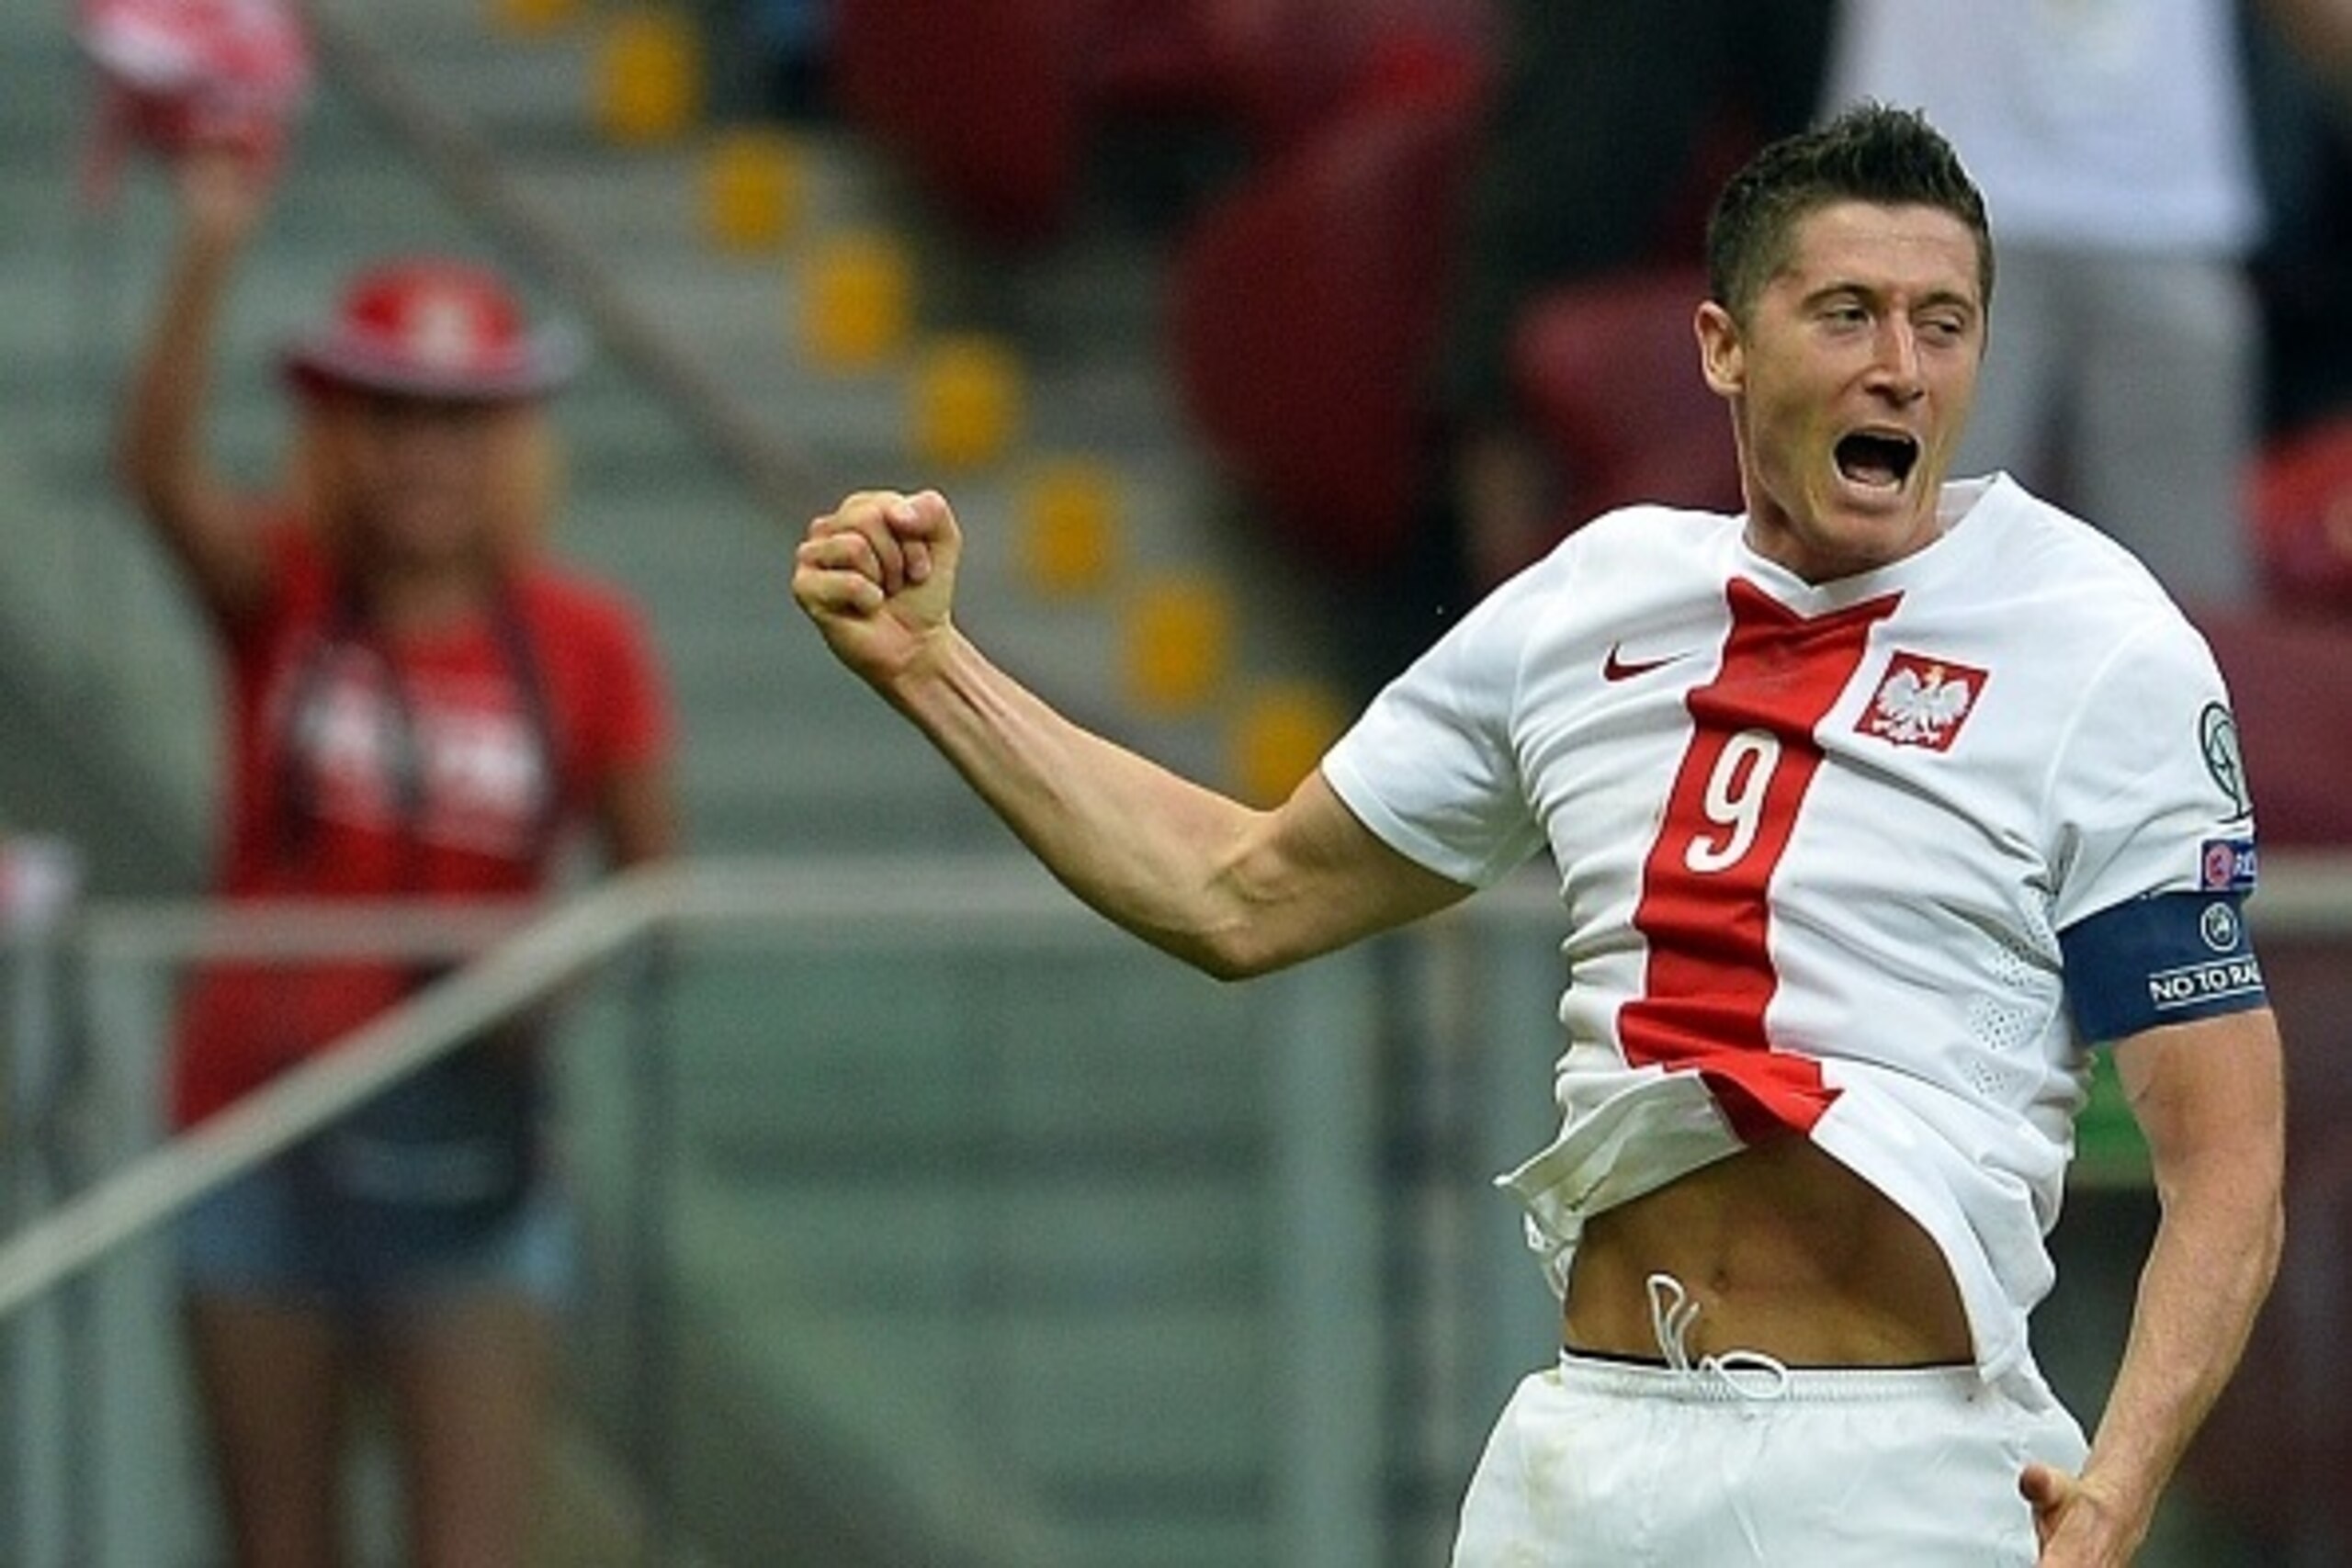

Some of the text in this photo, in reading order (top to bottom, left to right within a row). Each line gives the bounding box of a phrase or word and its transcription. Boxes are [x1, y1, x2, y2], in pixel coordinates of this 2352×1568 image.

[1685, 730, 1780, 872] 9
[2149, 976, 2194, 1001] NO
[2194, 970, 2228, 991] TO
